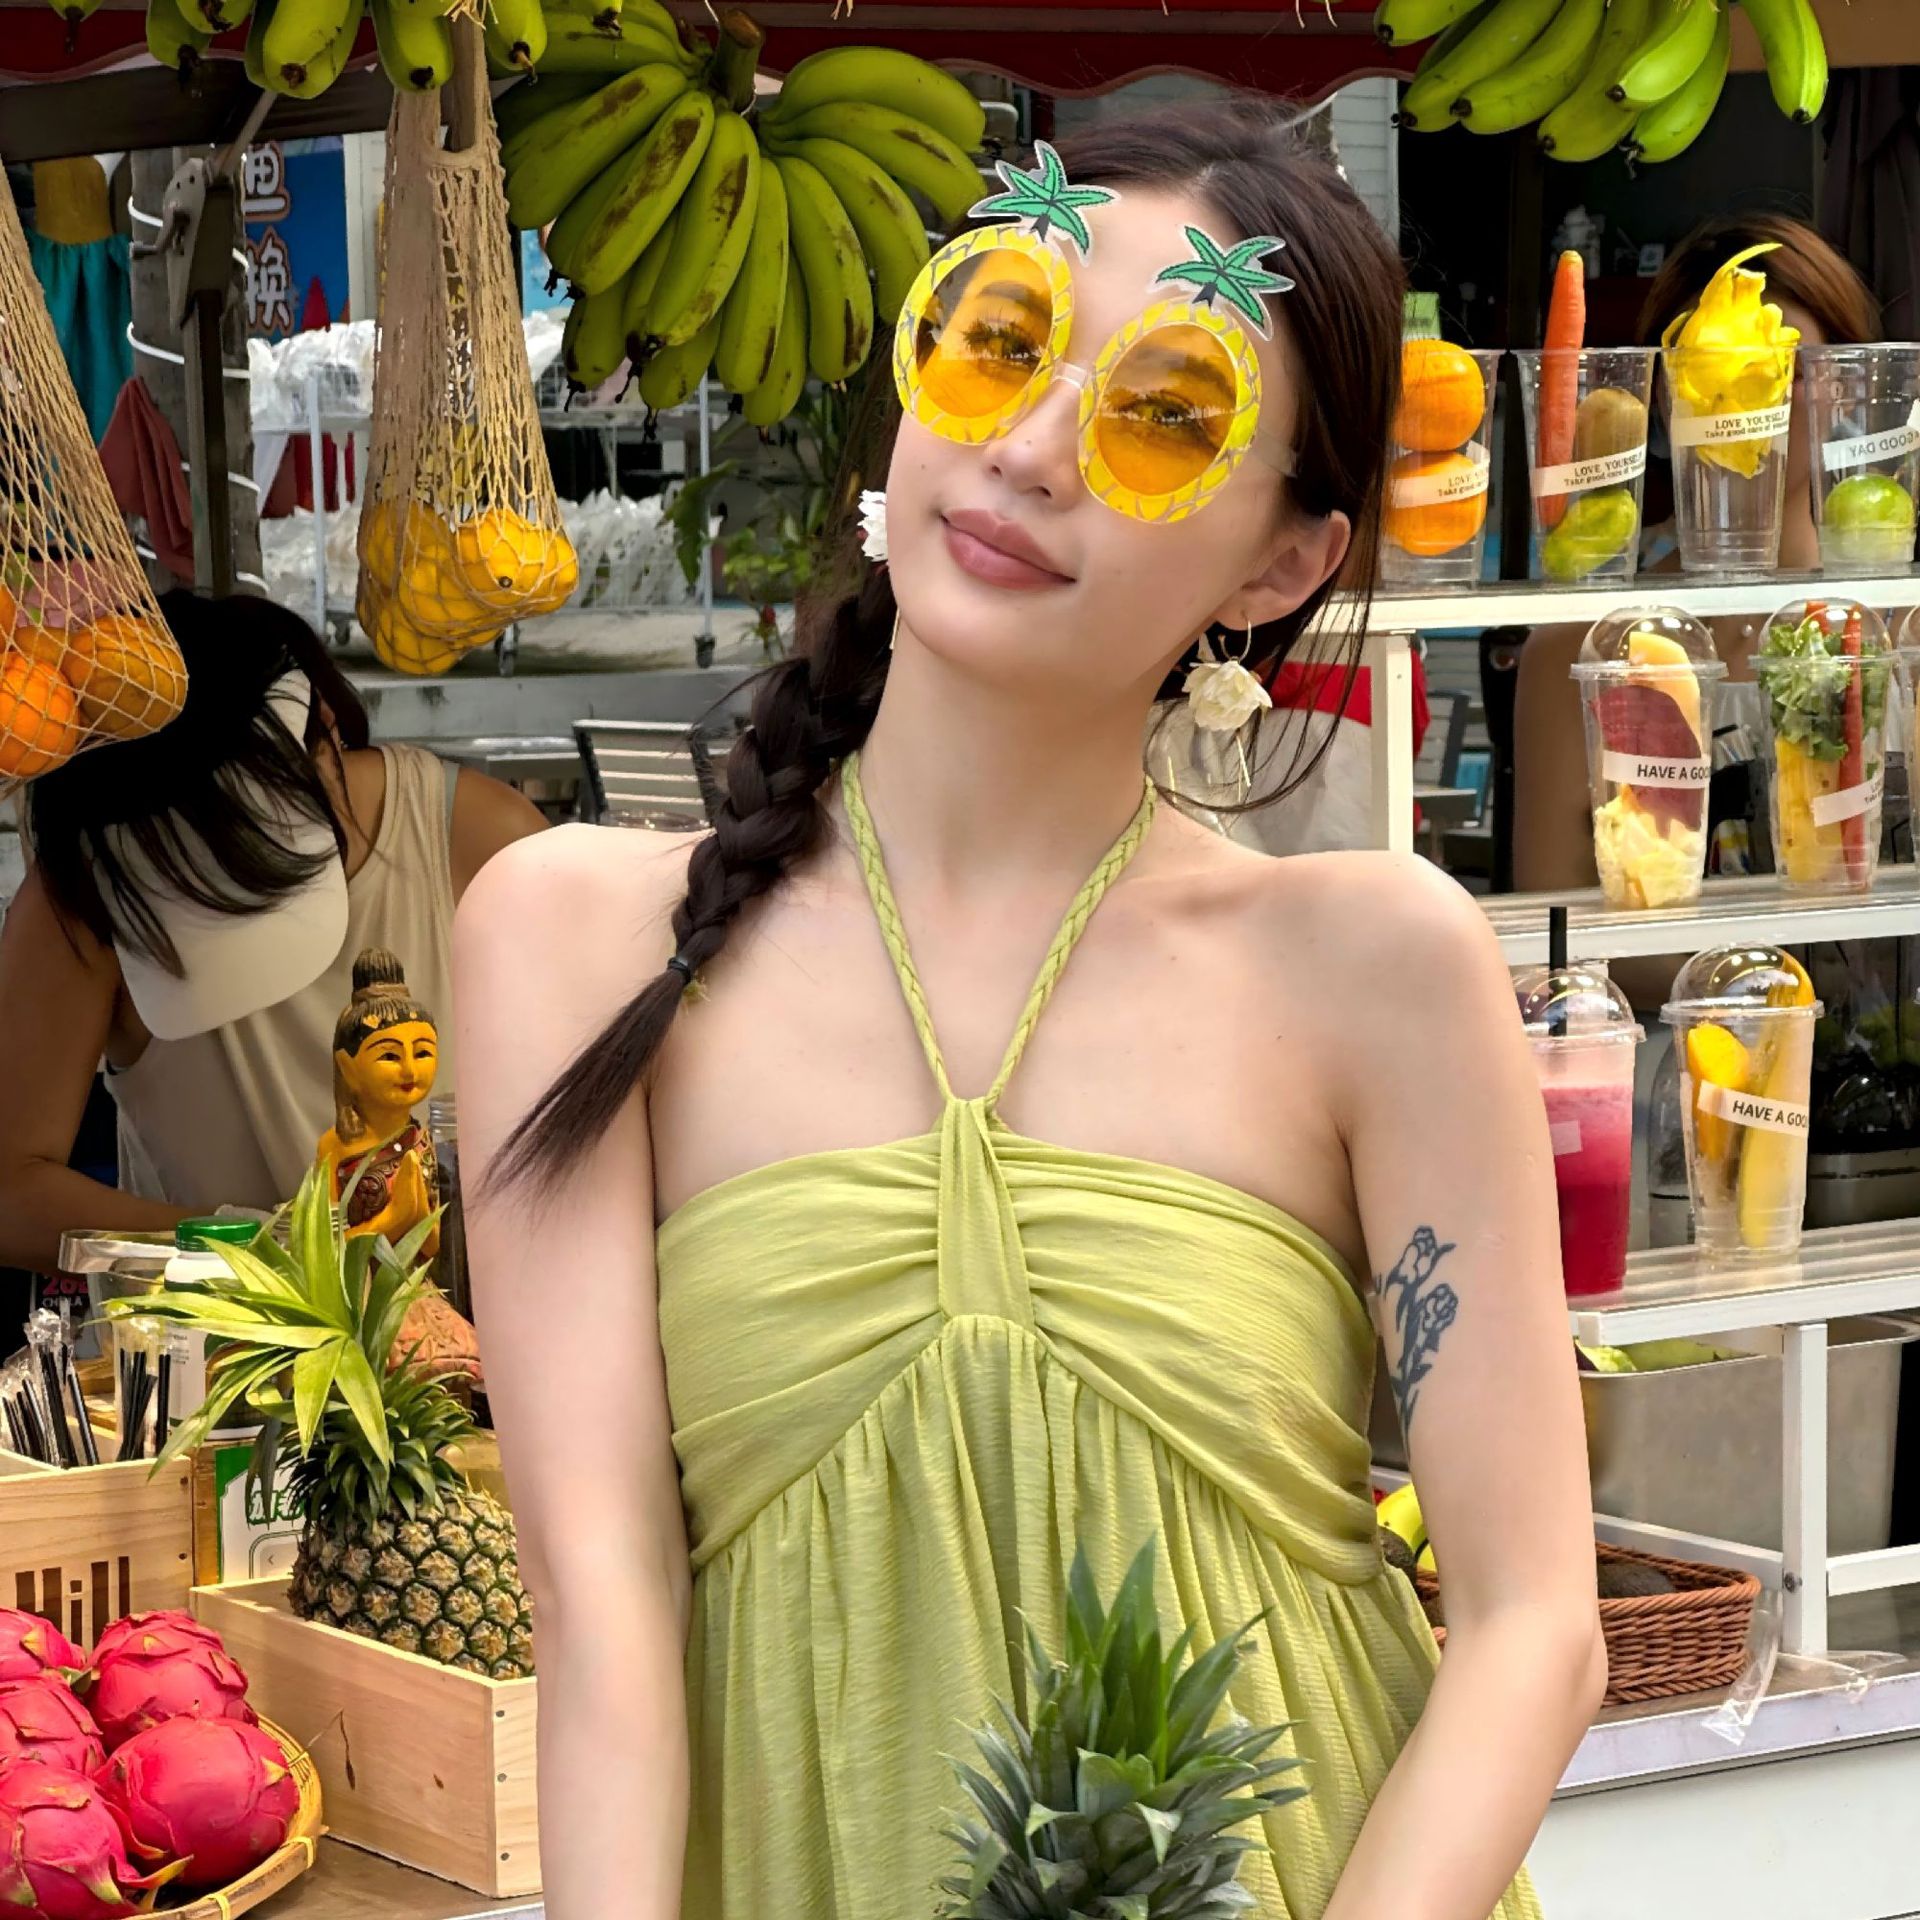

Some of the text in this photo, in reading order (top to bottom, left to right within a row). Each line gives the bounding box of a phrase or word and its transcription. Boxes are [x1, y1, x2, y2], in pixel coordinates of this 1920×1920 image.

[1715, 418, 1741, 430] LOVE
[1575, 464, 1601, 477] LOVE
[1637, 764, 1676, 779] HAVE
[1679, 766, 1688, 780] A
[1732, 1100, 1773, 1122] HAVE
[1775, 1110, 1784, 1124] A
